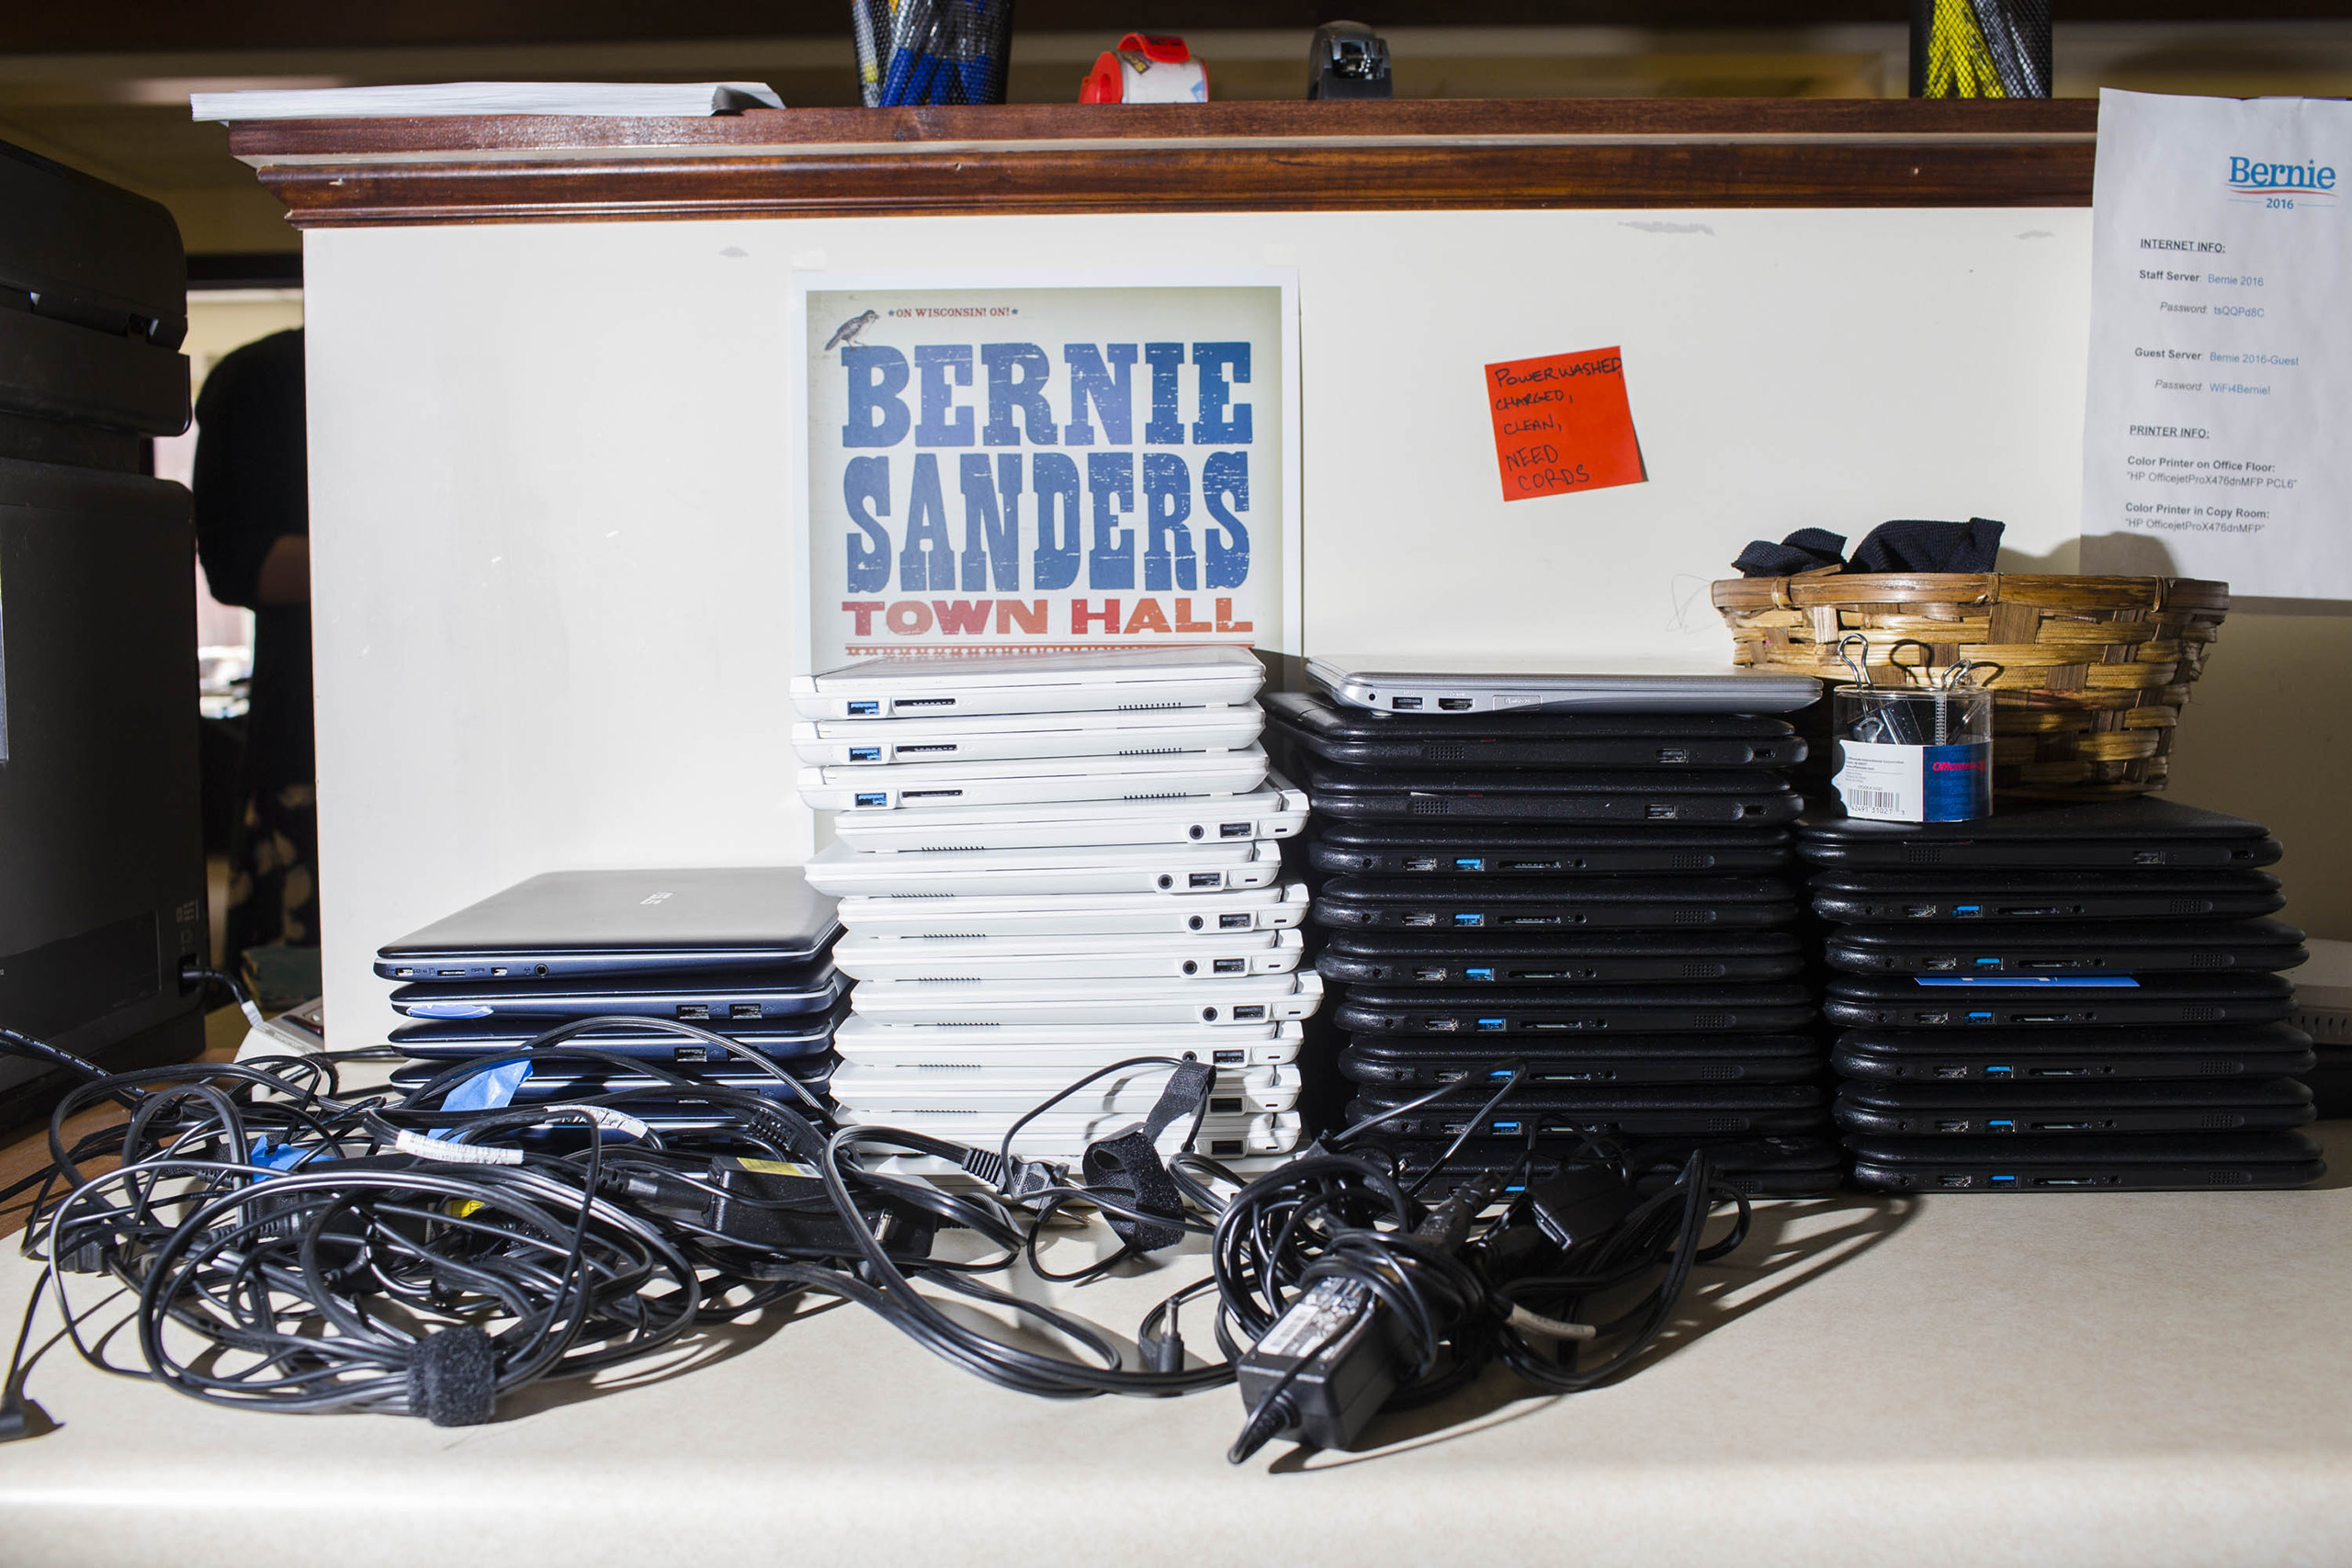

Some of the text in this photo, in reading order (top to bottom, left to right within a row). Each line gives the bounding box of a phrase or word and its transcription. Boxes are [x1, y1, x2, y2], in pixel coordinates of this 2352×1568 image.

[2229, 156, 2336, 189] Bernie
[2266, 197, 2294, 209] 2016
[2140, 238, 2226, 254] INTERNET INFO:
[2139, 269, 2265, 287] Staff Server: Bernie 2016
[896, 307, 1010, 318] ON WISCONSIN! ON!
[2159, 301, 2208, 314] Password:
[2134, 346, 2165, 359] Guest
[2210, 352, 2240, 364] Bernie
[2242, 354, 2300, 367] 2016-Guest
[1494, 367, 1559, 388] POWER
[2154, 378, 2271, 396] Password: WiFi4Bernie!
[841, 342, 1253, 447] BERNIE
[1495, 389, 1574, 411] CHARGED,
[1503, 413, 1562, 435] CLEAN,
[2129, 424, 2211, 439] PRINTER INFO:
[1505, 444, 1559, 471] NEED
[2127, 455, 2276, 473] Color Printer on Office Floor:
[1518, 464, 1590, 491] CORDS
[2125, 502, 2270, 519] Color Printer in Copy Room:
[842, 450, 1250, 593] SANDERS
[841, 597, 1254, 637] TOWN HALL
